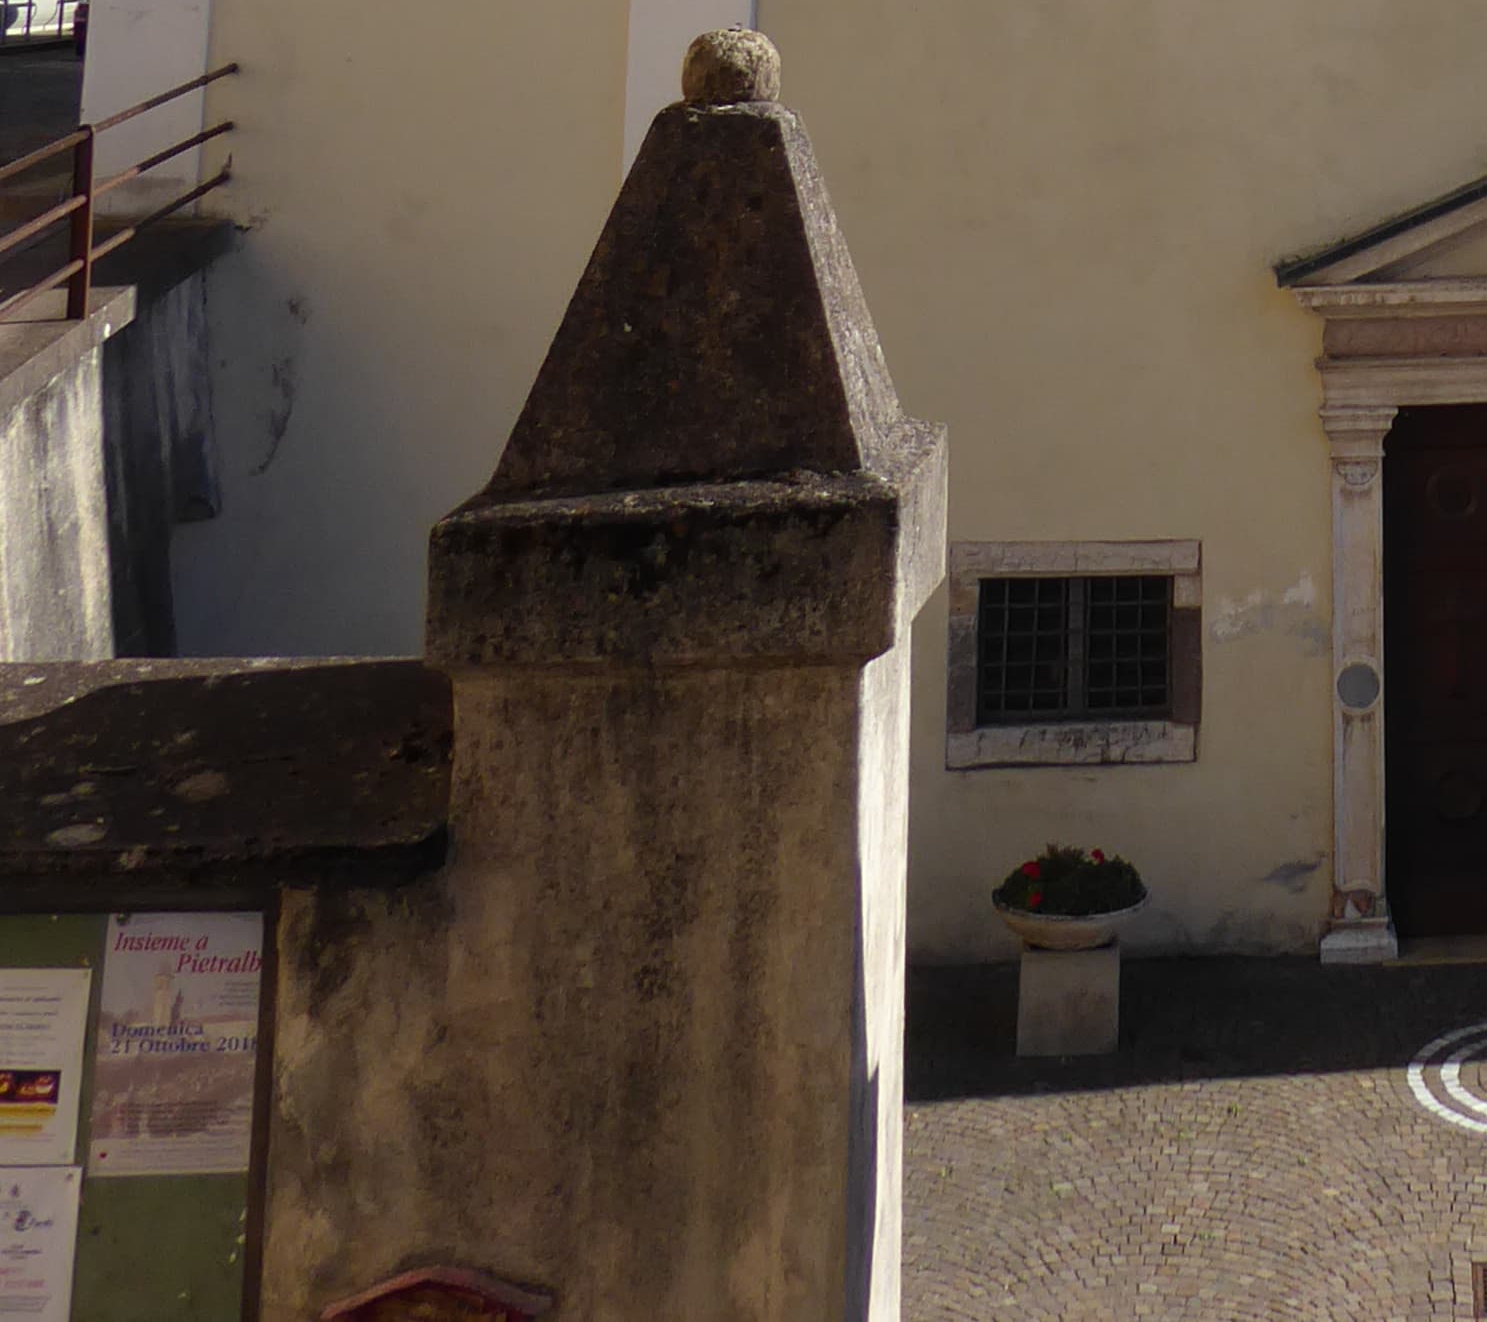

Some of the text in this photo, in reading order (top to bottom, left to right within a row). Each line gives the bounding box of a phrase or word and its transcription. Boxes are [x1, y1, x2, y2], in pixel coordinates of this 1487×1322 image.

[114, 932, 209, 951] Insieme a
[111, 1023, 204, 1037] Domenica
[111, 1040, 130, 1053] 21
[139, 1038, 209, 1052] Ottobre
